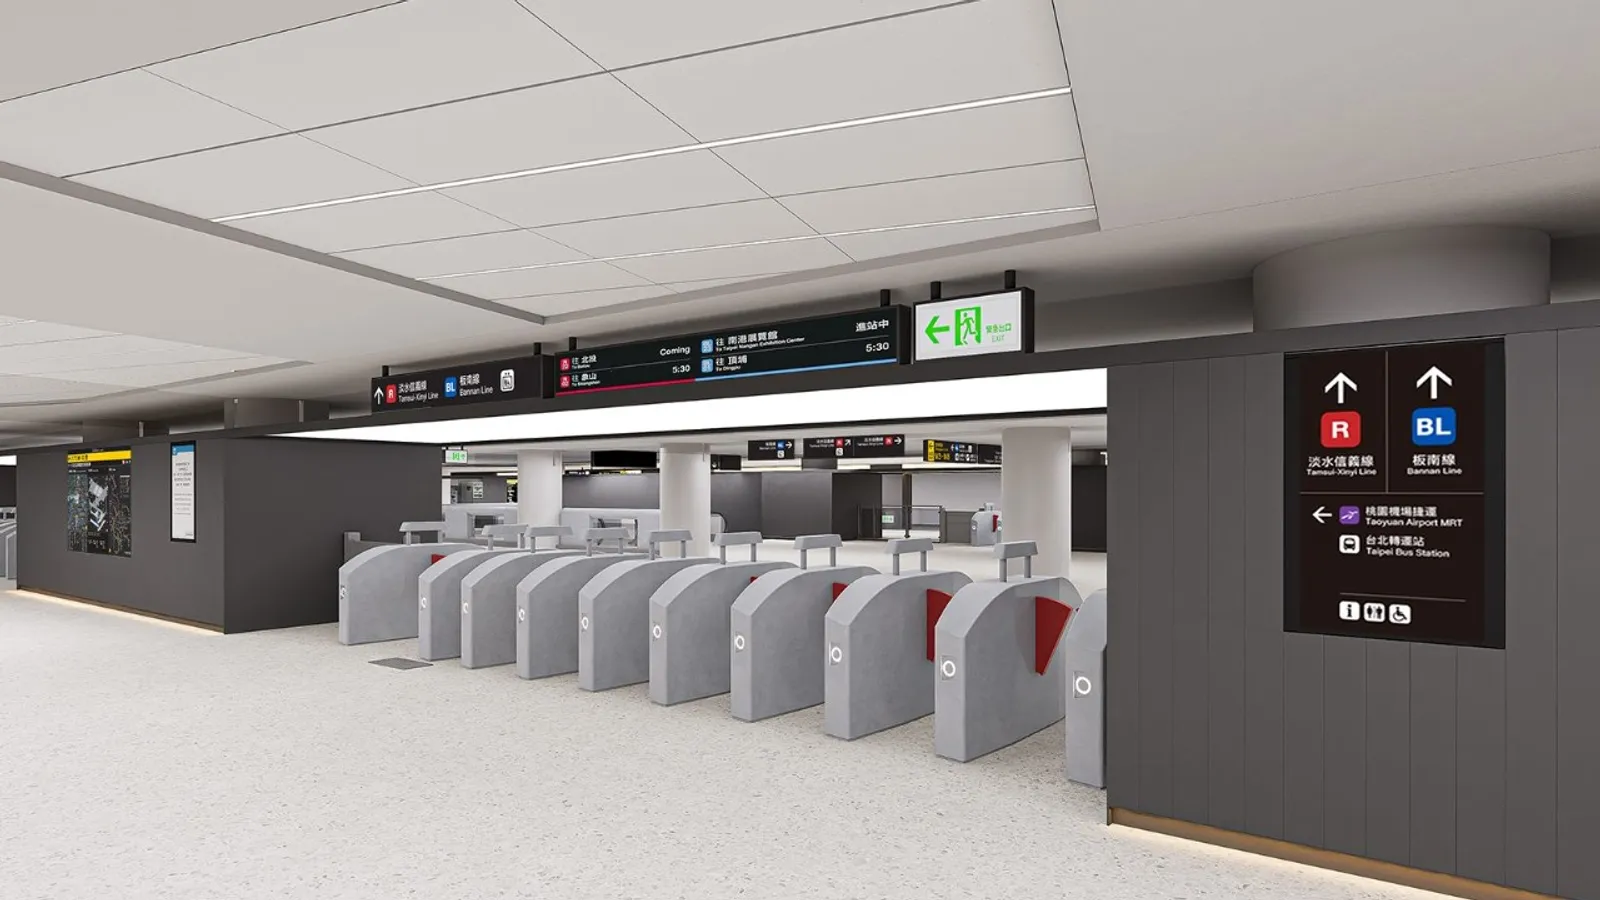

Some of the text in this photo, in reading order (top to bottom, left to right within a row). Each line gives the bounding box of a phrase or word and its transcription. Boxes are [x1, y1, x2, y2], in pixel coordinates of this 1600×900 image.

[855, 319, 889, 332] 進站中
[787, 336, 805, 344] Center
[660, 346, 691, 356] Coming
[865, 341, 890, 353] 5:30
[672, 364, 691, 374] 5:30
[446, 382, 456, 393] BL
[459, 385, 494, 397] Bannan Line
[428, 391, 439, 400] Line
[1331, 421, 1350, 438] R
[1416, 417, 1452, 436] BL
[1308, 455, 1374, 468] 淡水信義線
[1412, 453, 1456, 467] 板南線
[1306, 468, 1358, 477] Tamsui-Xinyi
[1407, 466, 1463, 475] Bannan Line
[1365, 506, 1438, 518] 桃園機場捷運
[1365, 517, 1464, 528] Taoyuan Airport MRT
[1366, 535, 1425, 547] 台北轉運站
[1366, 547, 1450, 558] Taipei Bus Station
